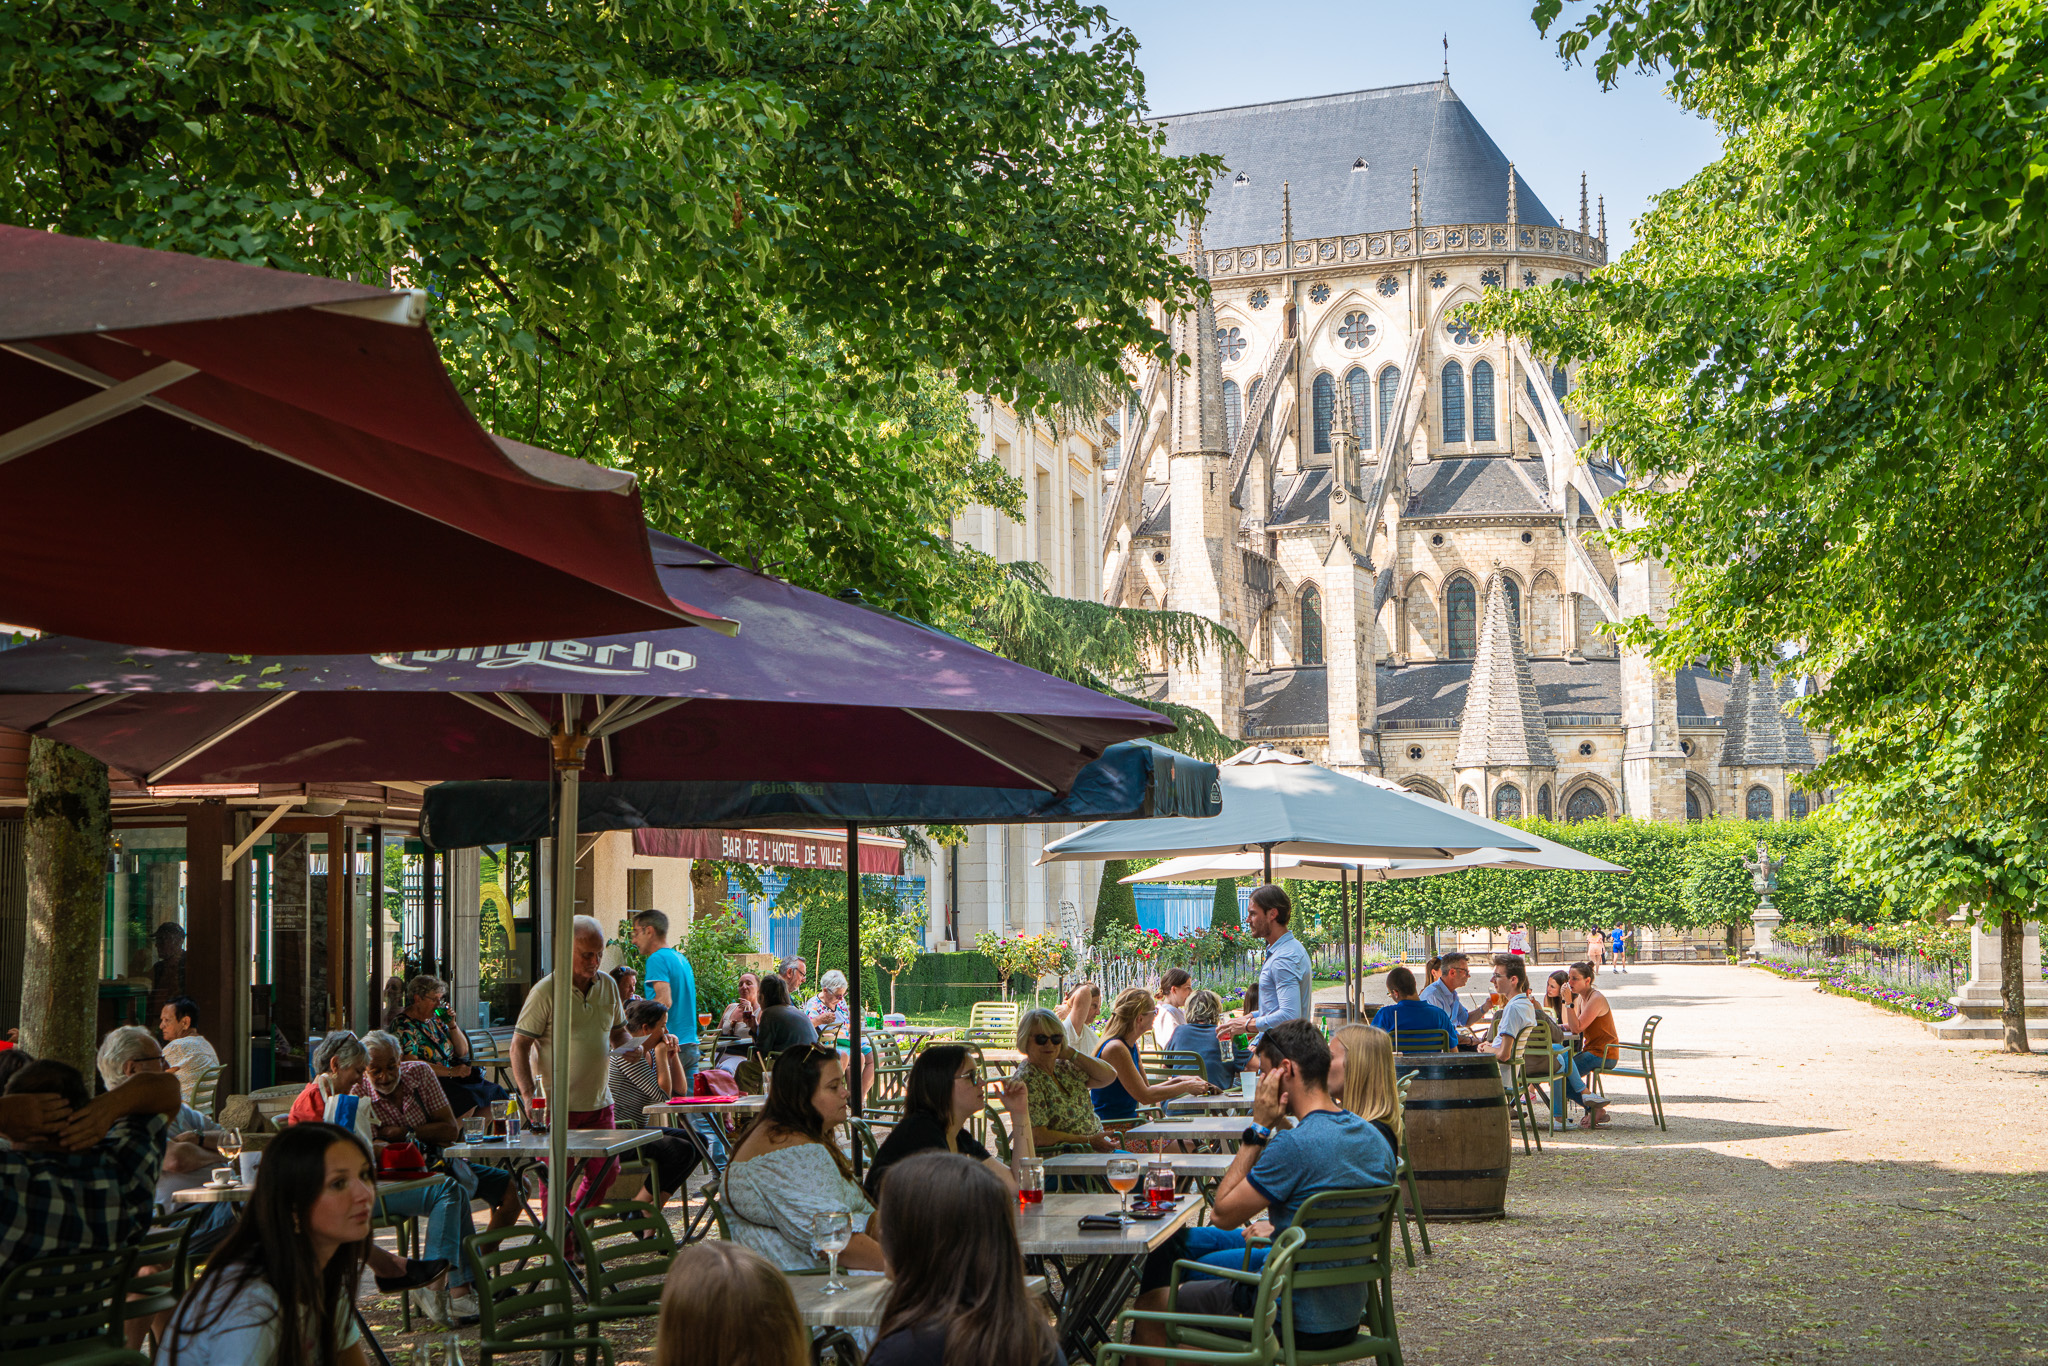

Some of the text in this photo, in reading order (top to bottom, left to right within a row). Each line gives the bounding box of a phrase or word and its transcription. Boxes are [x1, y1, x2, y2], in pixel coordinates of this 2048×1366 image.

[751, 781, 824, 797] Heineken
[722, 836, 842, 867] BAR DE L'HOTEL DE VILLE
